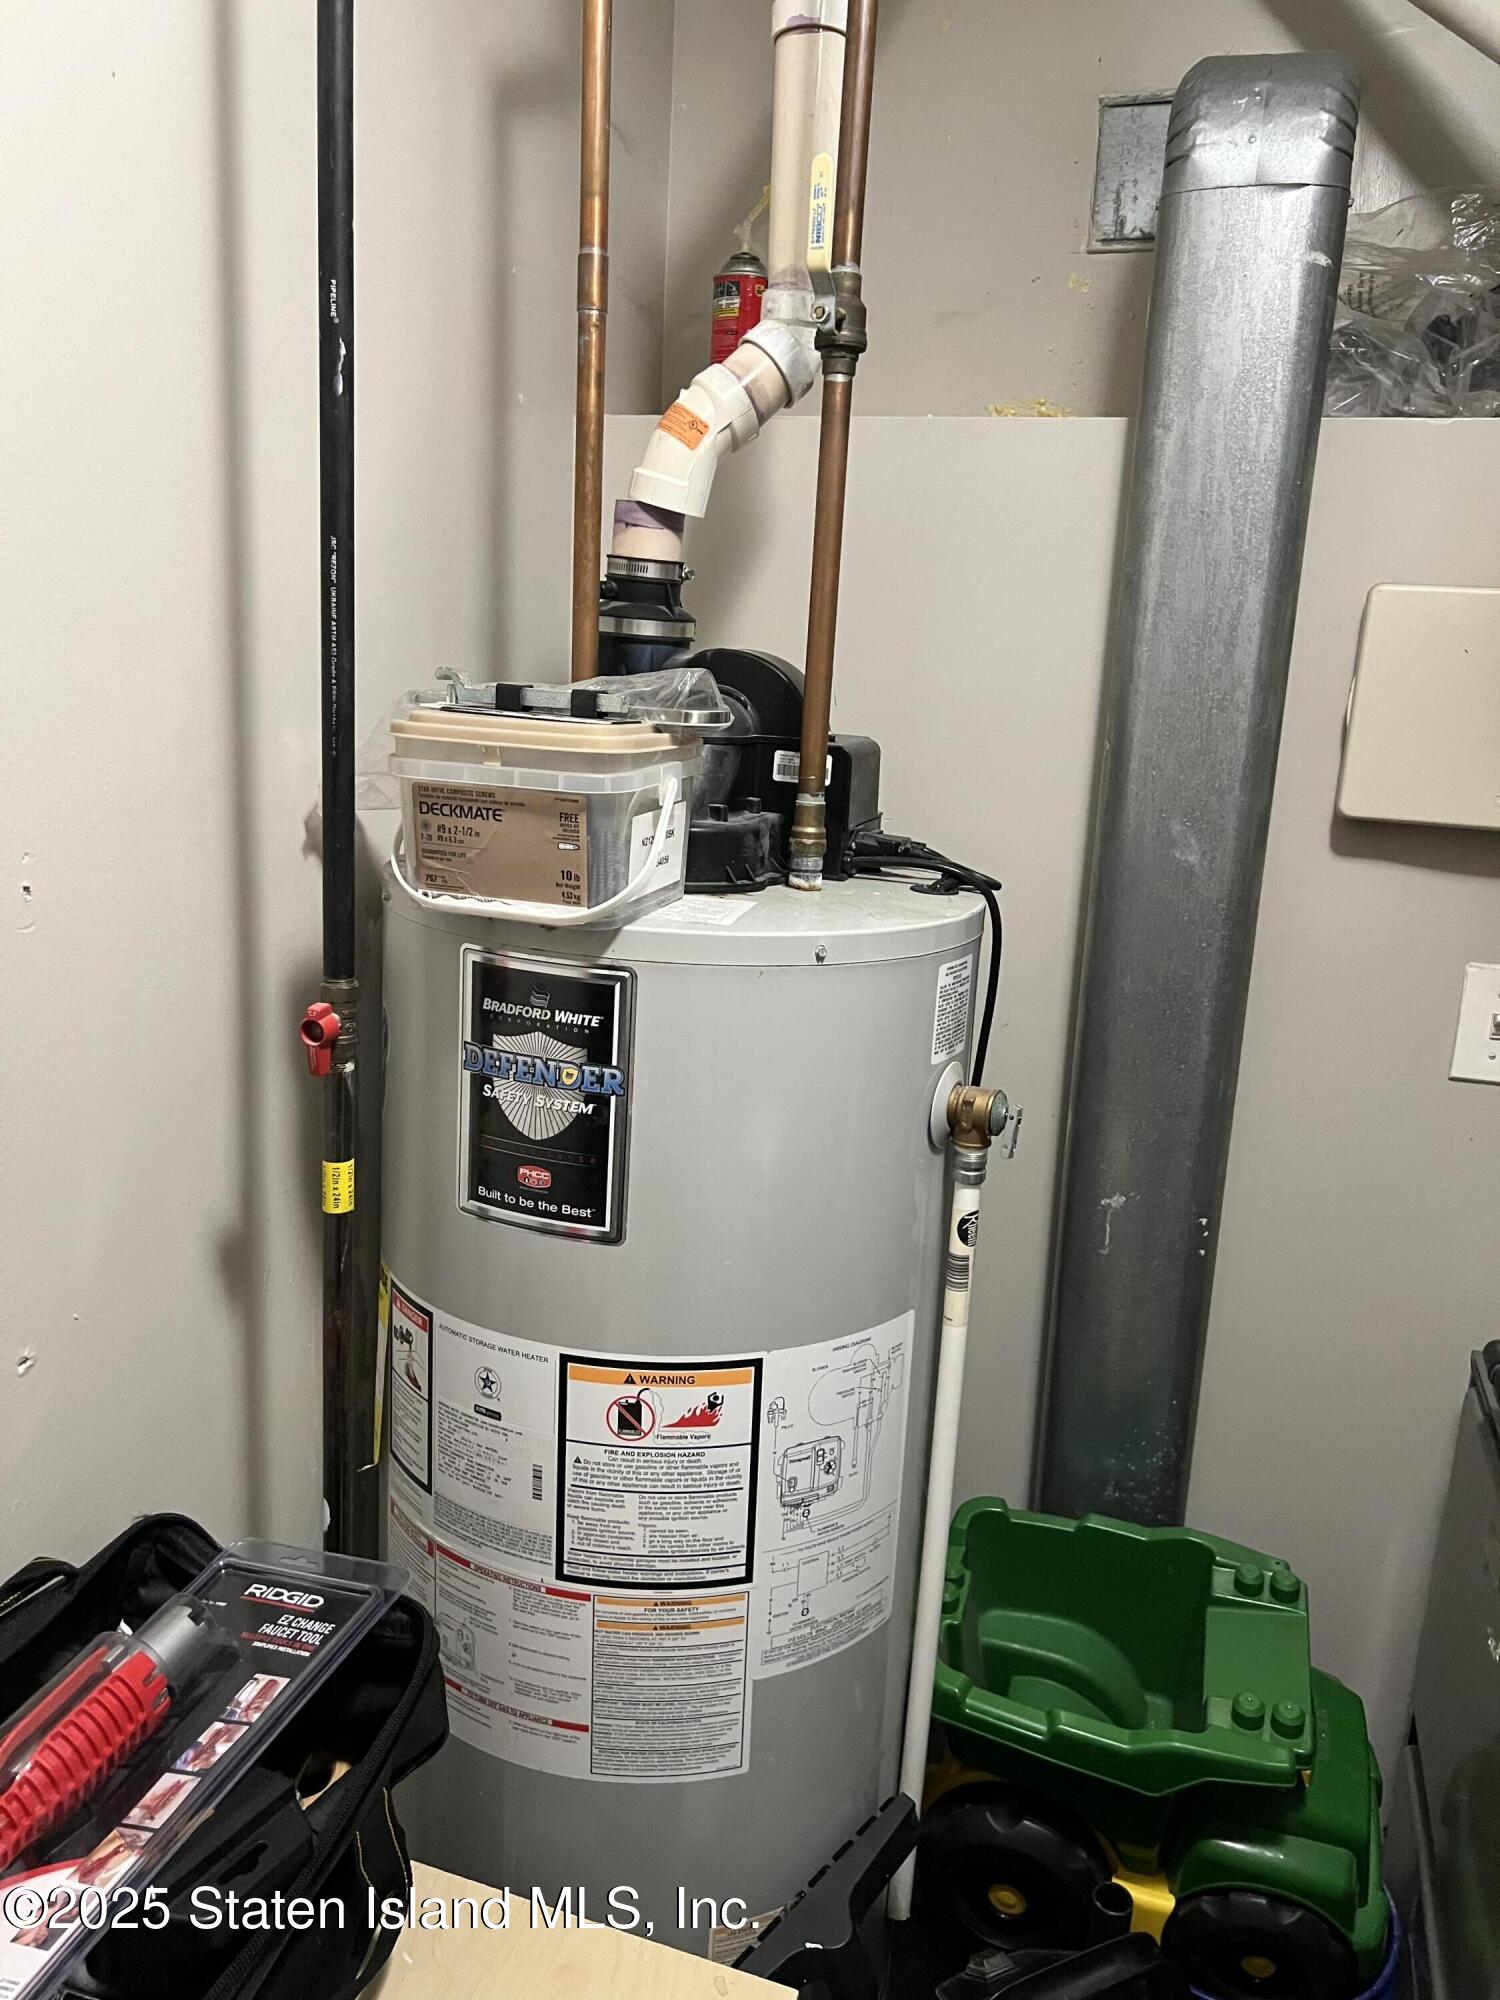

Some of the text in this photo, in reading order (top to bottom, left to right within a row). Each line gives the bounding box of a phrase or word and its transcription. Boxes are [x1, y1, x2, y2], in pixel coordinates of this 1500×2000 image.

[475, 790, 496, 798] SCREWS
[419, 801, 503, 822] DECKMATE
[560, 812, 580, 823] FREE
[437, 824, 446, 833] #9
[454, 826, 473, 837] 2-1/2
[560, 870, 580, 881] 10 lb
[482, 997, 600, 1027] BRADFORD WHITE
[464, 1041, 625, 1097] DEFENDER
[482, 1084, 594, 1115] SAFETY SYSTEM
[332, 1168, 340, 1184] 1/2in
[519, 1168, 550, 1180] PHCC
[332, 1193, 341, 1208] 24in
[478, 1186, 592, 1218] Built to be the Best
[439, 1323, 549, 1364] AUTOMATIC STORAGE WATER HEATER
[640, 1375, 696, 1385] WARNING
[244, 1584, 324, 1608] RIDGID
[258, 1623, 324, 1645] FAUCET TOOL
[277, 1614, 336, 1634] EZ CHANGE
